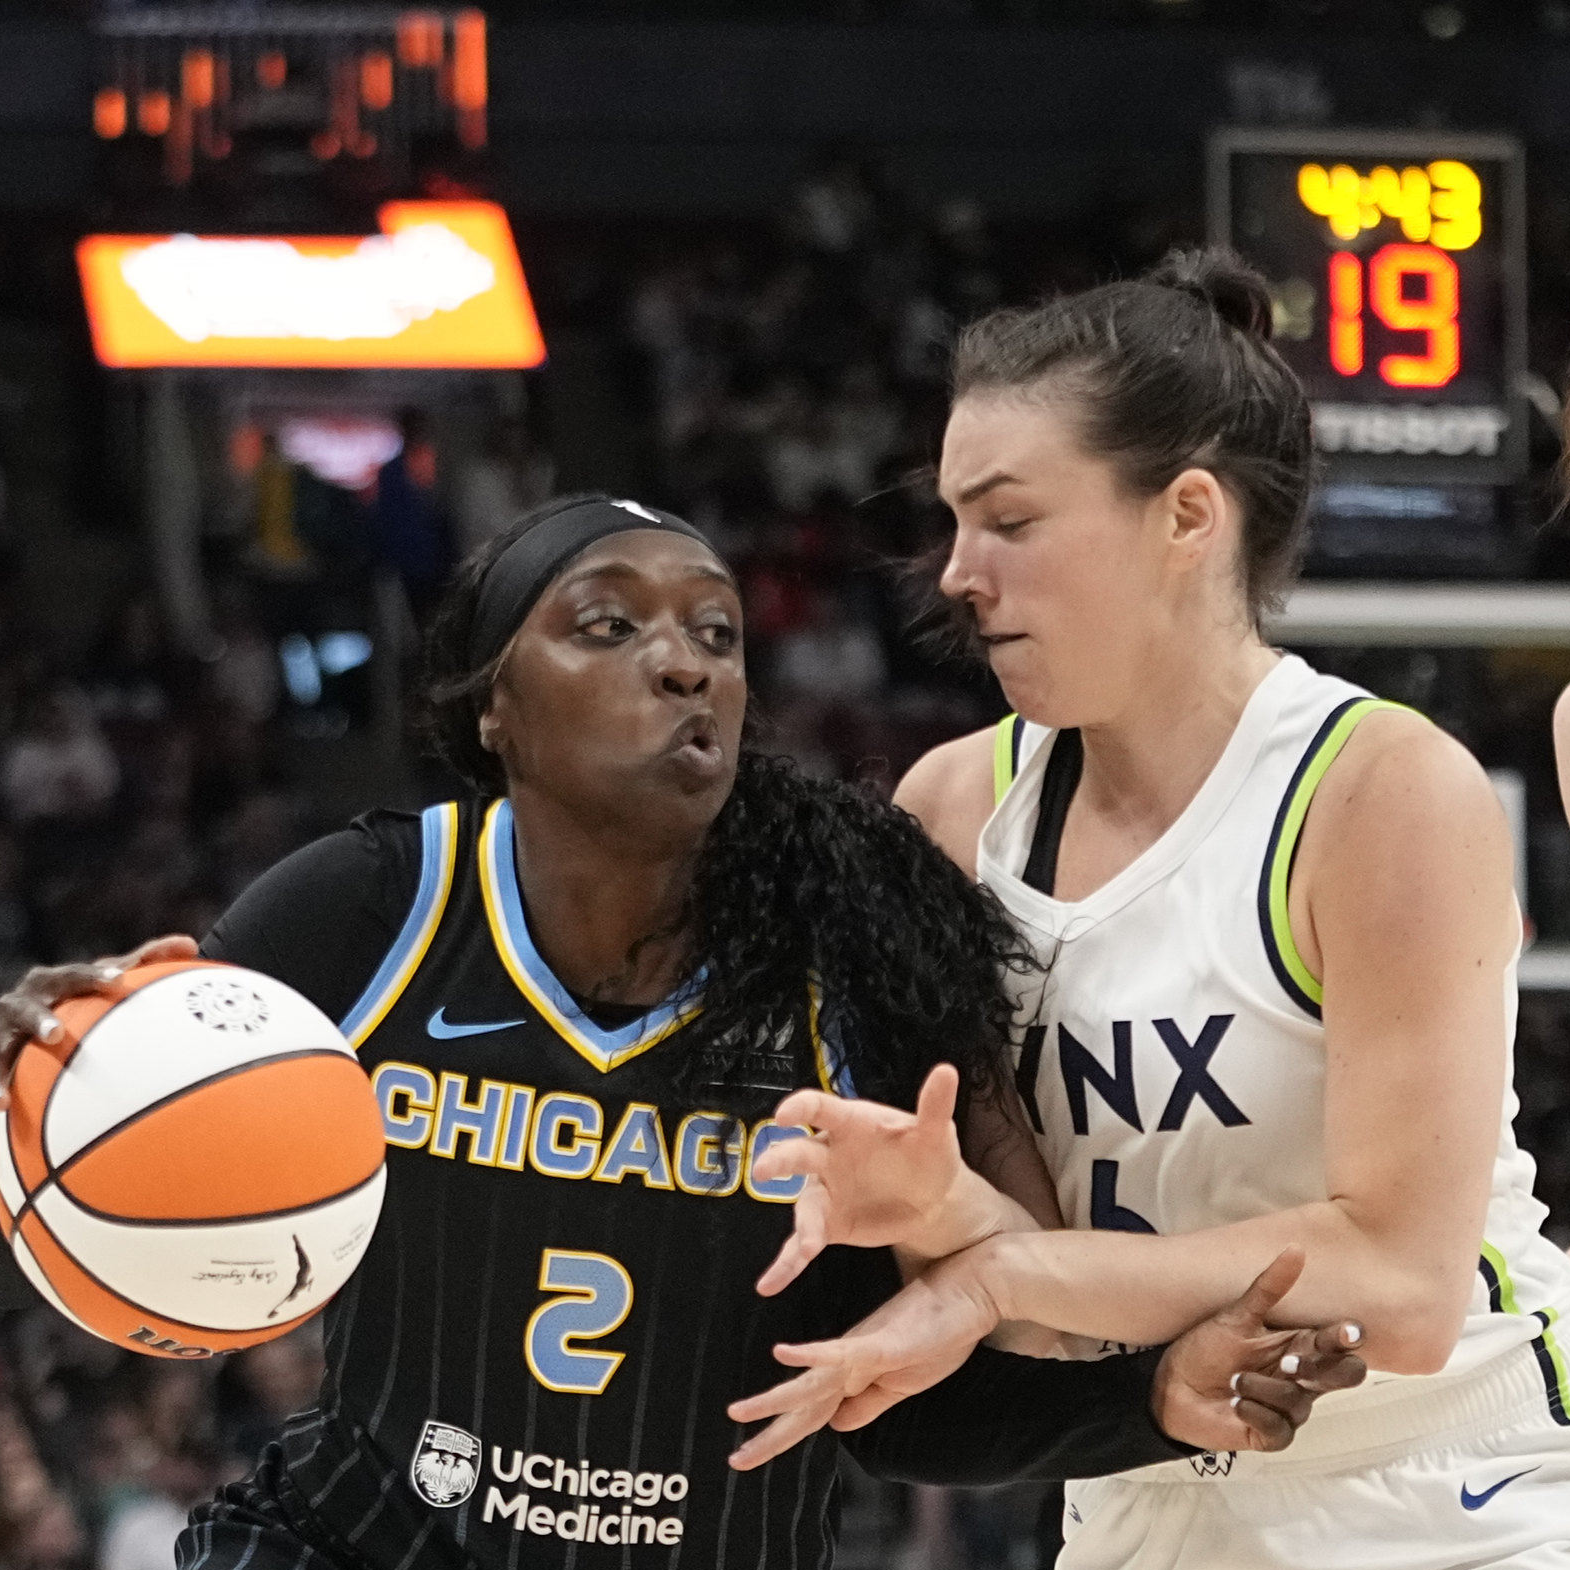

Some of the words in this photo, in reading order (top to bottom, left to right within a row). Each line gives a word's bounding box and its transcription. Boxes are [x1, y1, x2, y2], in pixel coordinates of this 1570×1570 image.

[1329, 243, 1461, 388] 19
[370, 1060, 814, 1204] CHICAGO
[524, 1247, 634, 1394] 2
[482, 1485, 684, 1546] Medicine
[491, 1445, 689, 1507] UChicago
